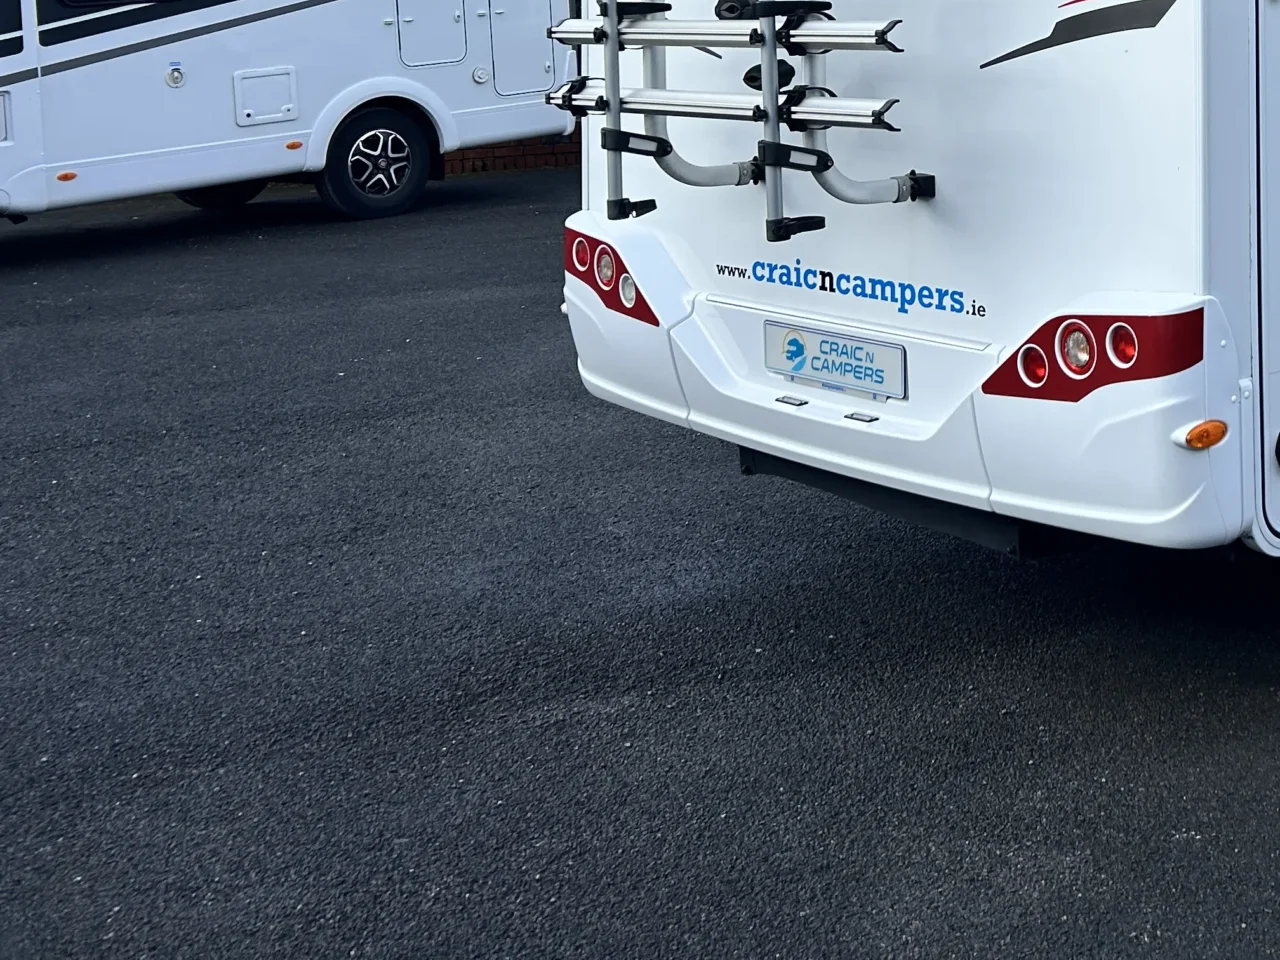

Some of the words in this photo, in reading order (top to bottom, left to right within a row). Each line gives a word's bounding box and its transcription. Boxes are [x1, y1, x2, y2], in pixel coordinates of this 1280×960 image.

[716, 258, 987, 318] www.craicncampers.ie
[819, 339, 864, 363] CRAIC
[865, 351, 875, 364] N
[810, 355, 885, 385] CAMPERS
